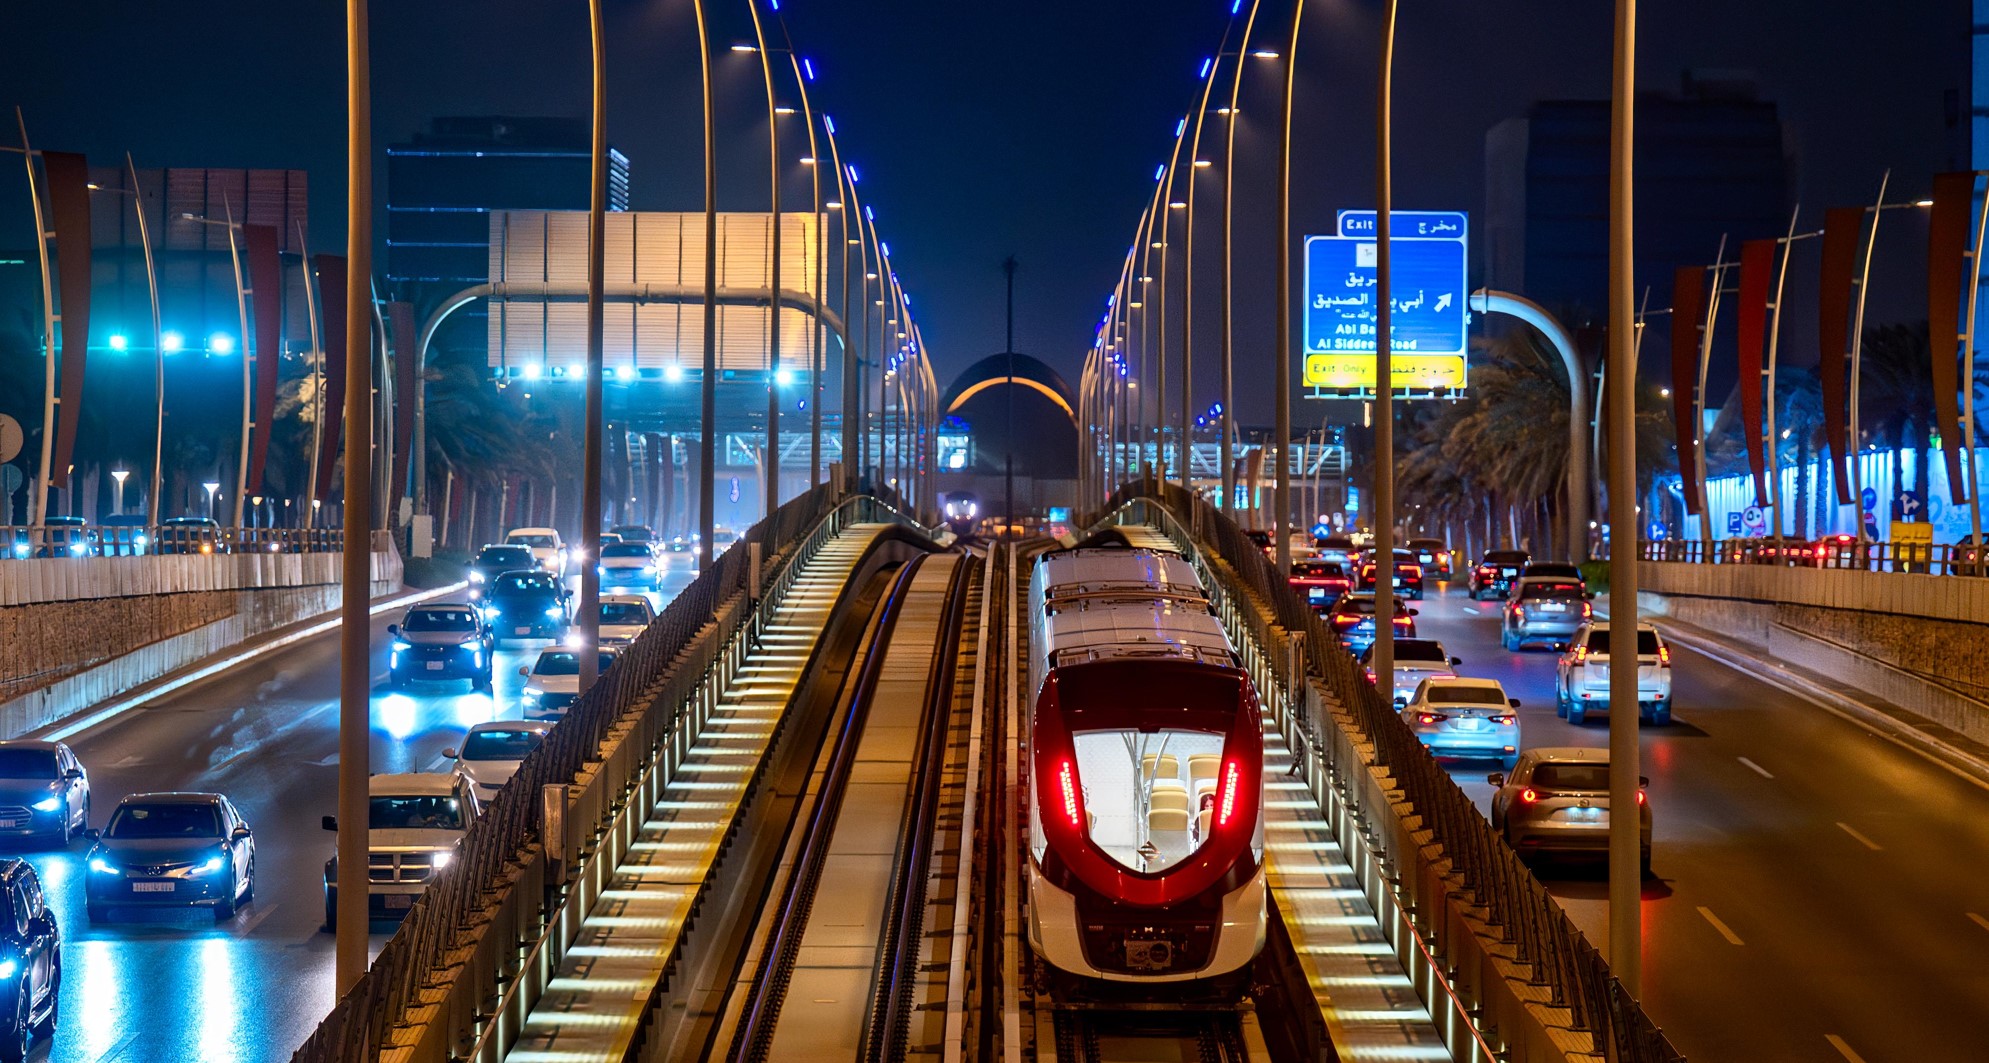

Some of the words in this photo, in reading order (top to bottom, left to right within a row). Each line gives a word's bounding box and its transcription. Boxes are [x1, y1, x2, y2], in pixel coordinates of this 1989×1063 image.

[1346, 219, 1373, 230] Exit
[1418, 220, 1457, 234] مخرج
[1345, 271, 1377, 288] ريق
[1313, 292, 1369, 309] الصديق
[1399, 289, 1424, 313] أبي
[1335, 323, 1357, 335] Abi
[1360, 323, 1396, 335] Bar
[1317, 338, 1331, 349] Al
[1388, 338, 1417, 350] Road
[1313, 363, 1335, 373] Exit
[1343, 363, 1367, 375] Only
